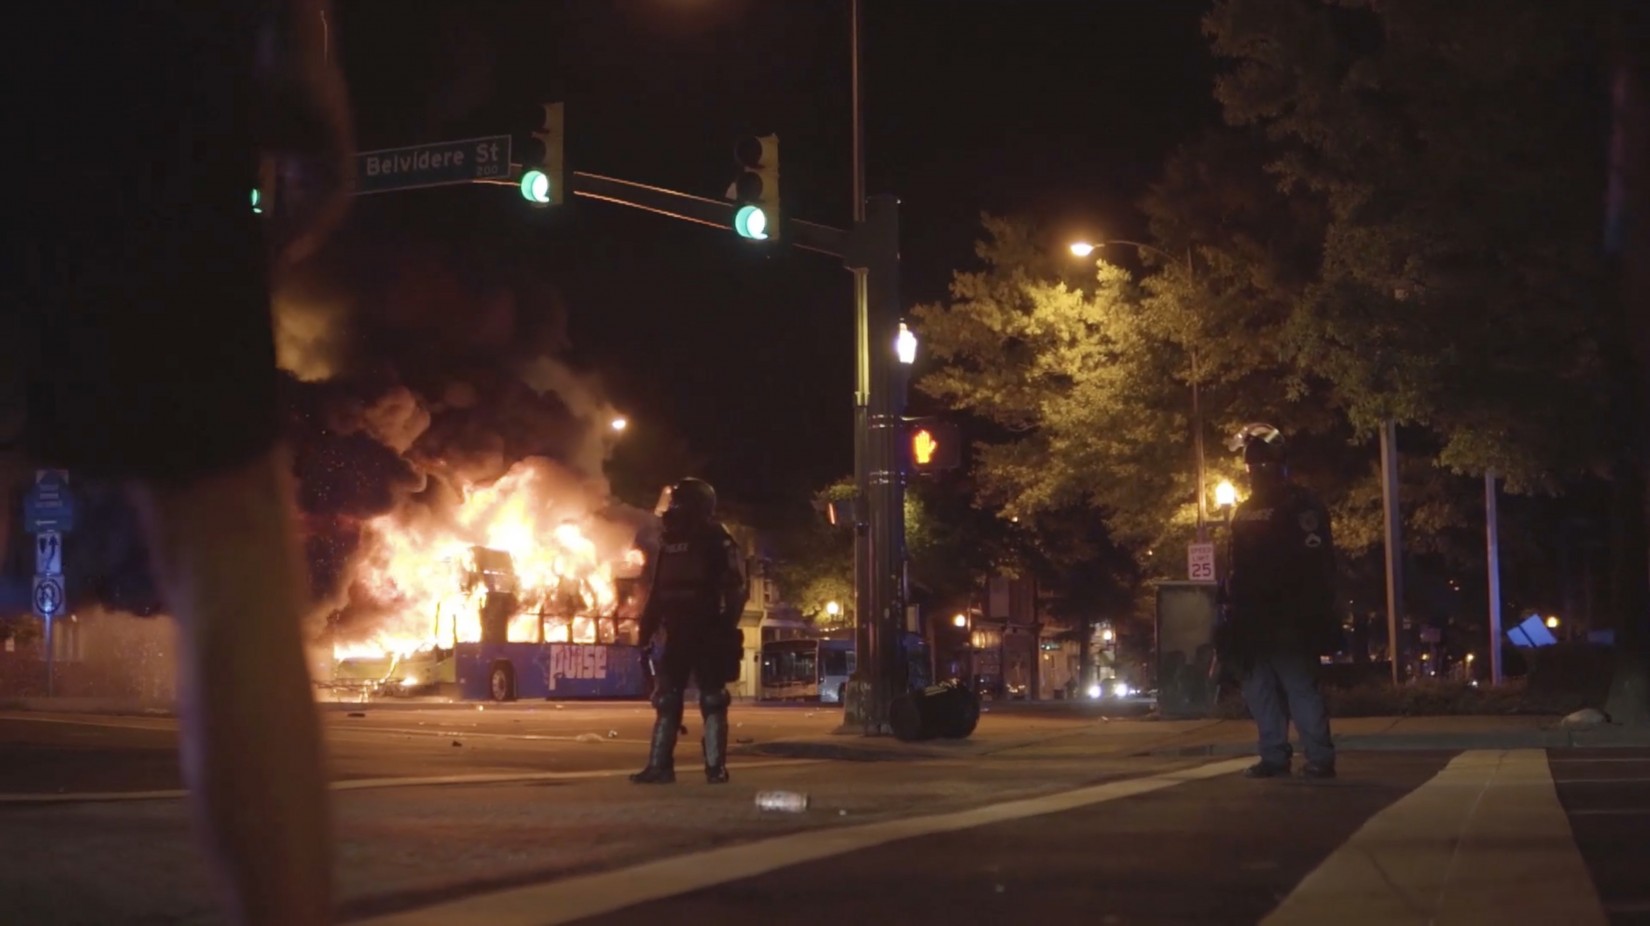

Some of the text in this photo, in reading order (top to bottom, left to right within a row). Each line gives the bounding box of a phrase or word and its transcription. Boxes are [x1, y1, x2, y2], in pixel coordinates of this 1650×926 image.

[366, 143, 499, 176] Belvidere St
[476, 165, 498, 176] 200
[1192, 563, 1211, 577] 25
